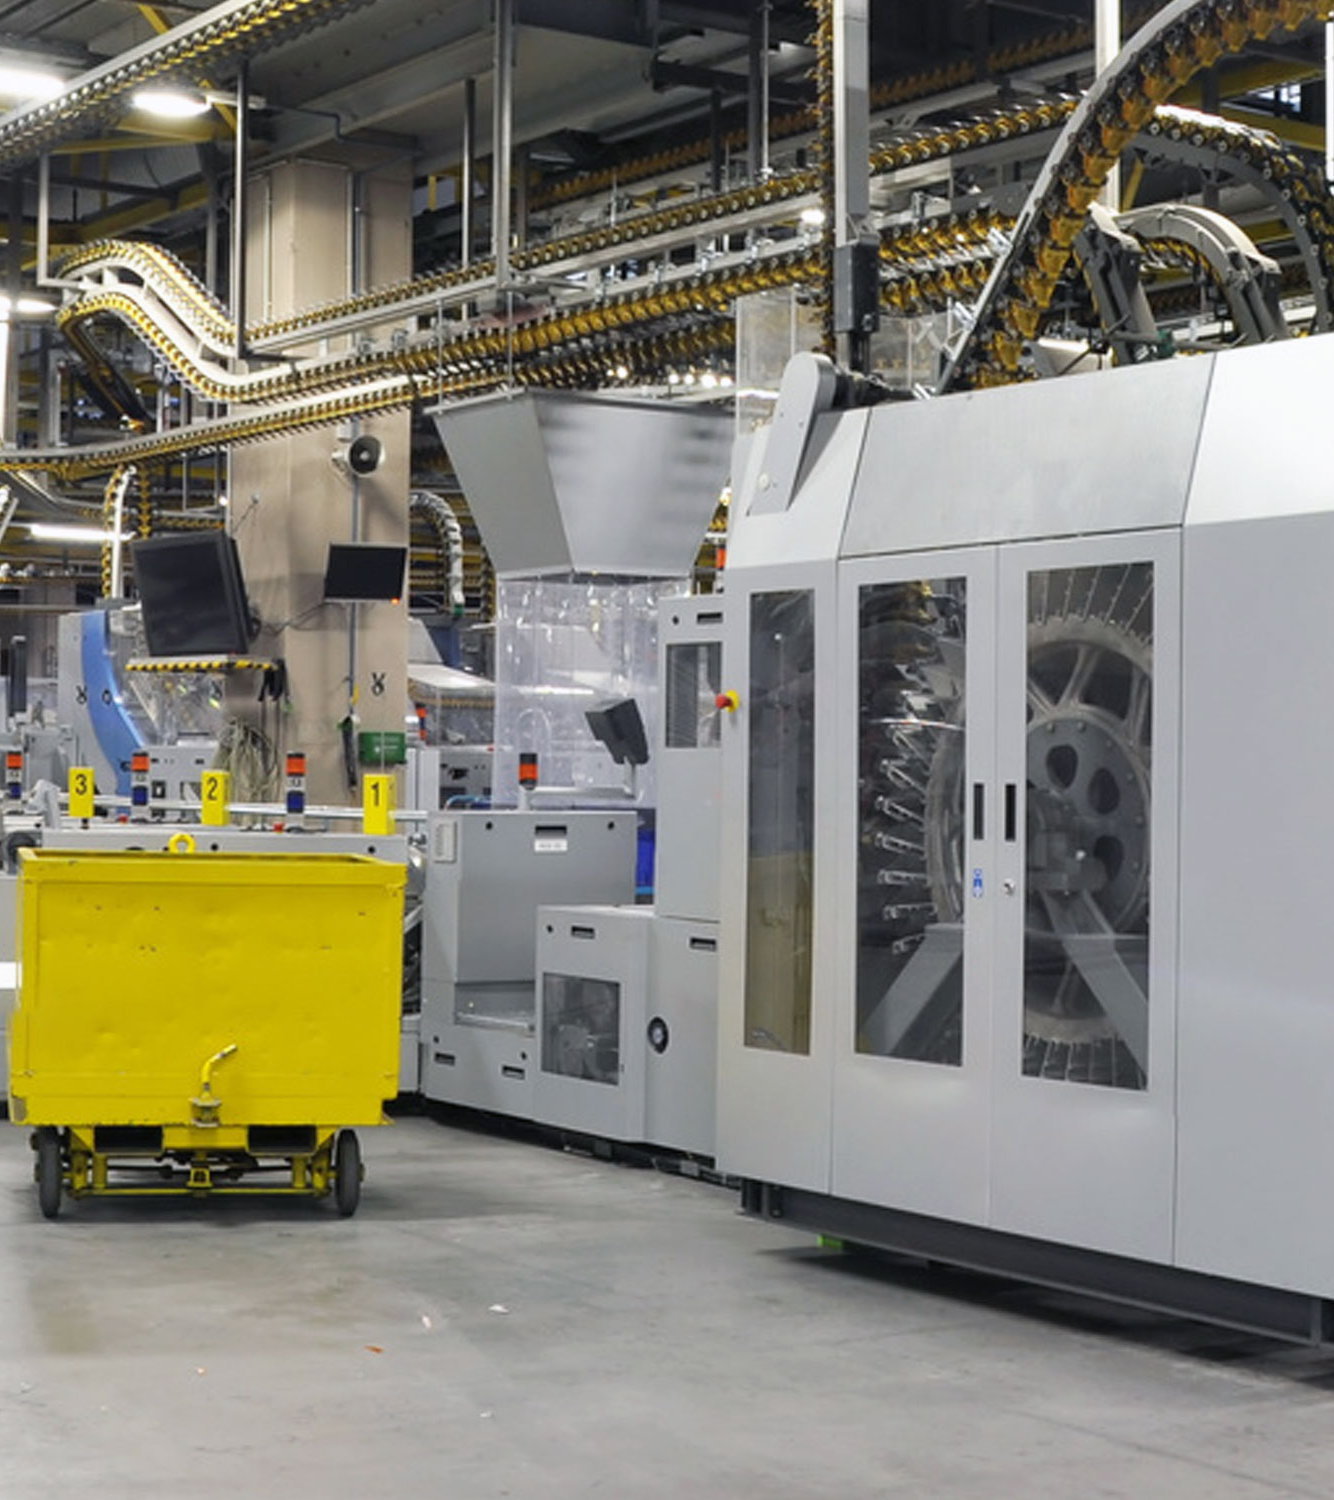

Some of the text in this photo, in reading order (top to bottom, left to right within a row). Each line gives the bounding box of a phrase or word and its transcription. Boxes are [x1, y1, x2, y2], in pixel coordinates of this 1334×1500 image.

[75, 773, 87, 795] 3
[206, 777, 218, 800] 2
[371, 781, 380, 806] 1
